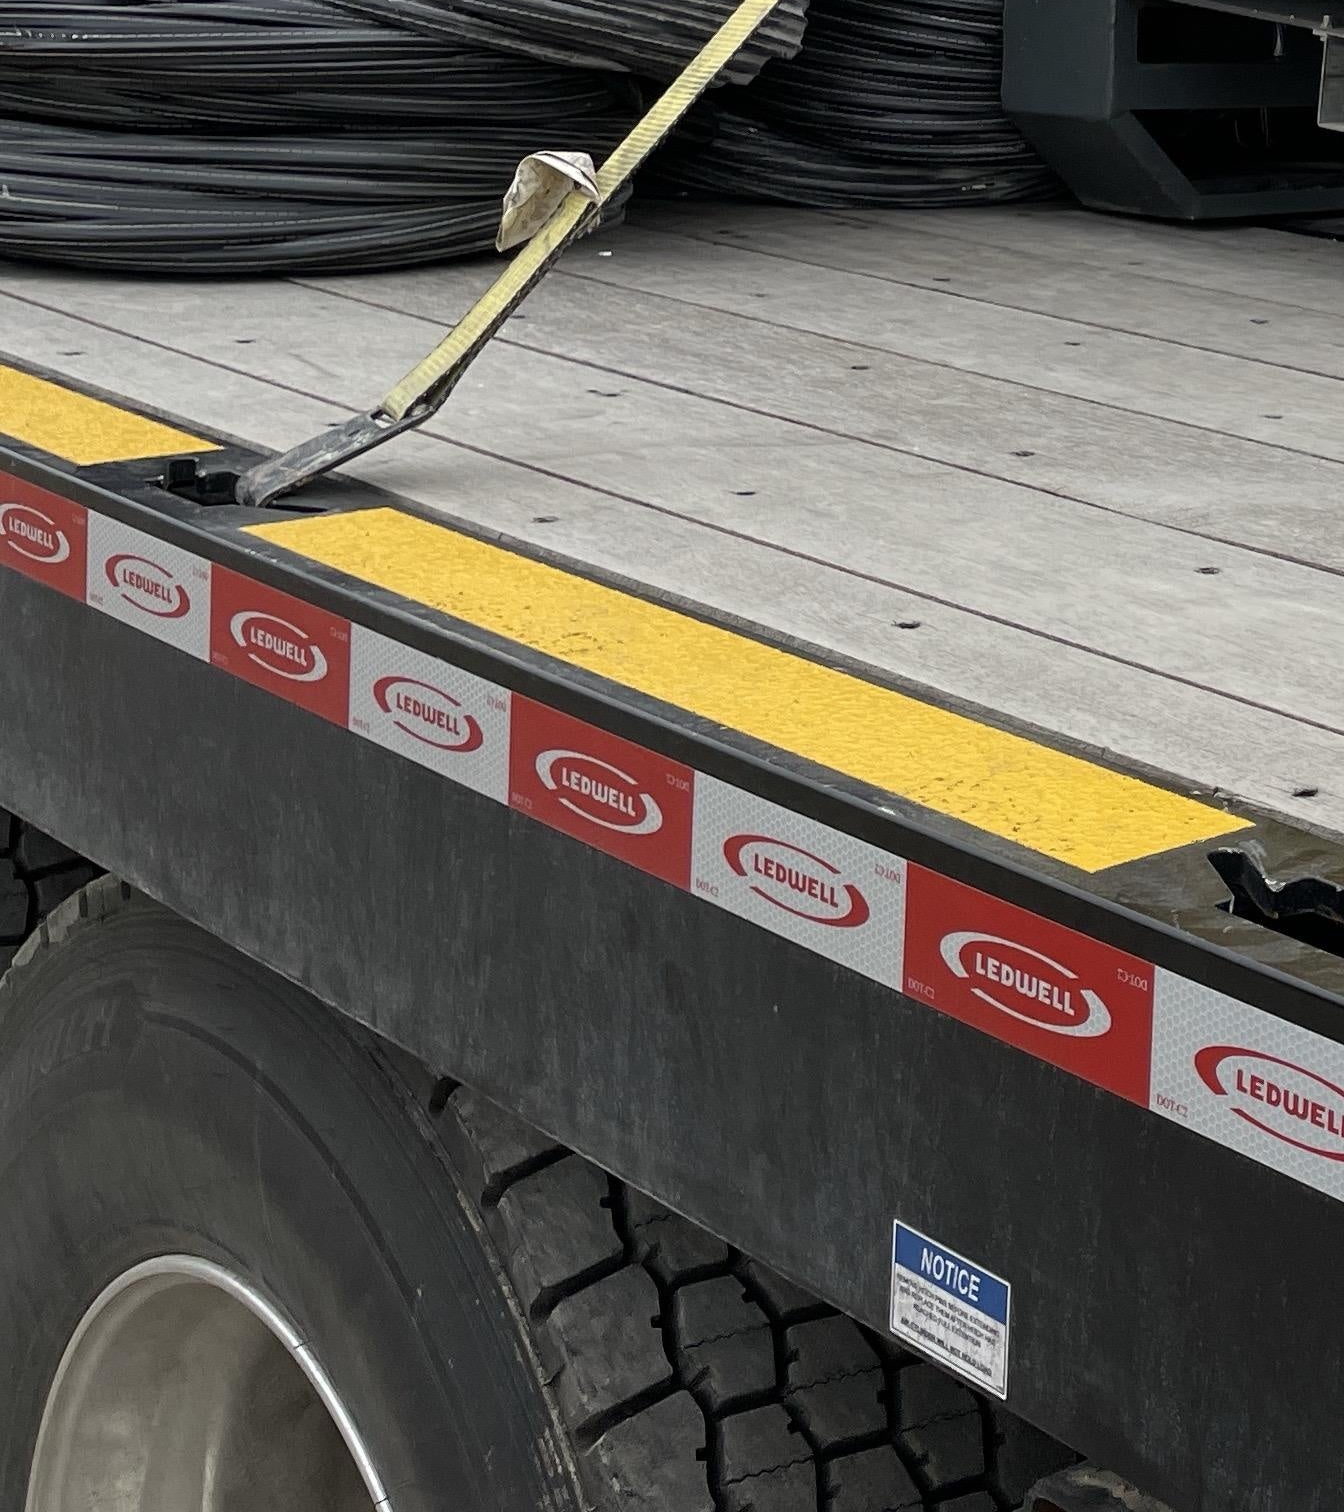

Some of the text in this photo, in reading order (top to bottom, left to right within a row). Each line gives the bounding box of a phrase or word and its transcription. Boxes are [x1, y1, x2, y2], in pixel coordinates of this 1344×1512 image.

[8, 515, 54, 550] LEDWELL
[122, 567, 173, 604] LEDWELL
[249, 625, 308, 667] LEDWELL
[395, 691, 461, 736] LEDWELL
[561, 766, 637, 818] LEDWELL
[753, 852, 839, 908] LEDWELL
[907, 977, 936, 1000] DOT-C2
[975, 951, 1076, 1017] LEDWELL
[1116, 967, 1149, 992] DOT-C2
[1155, 1093, 1189, 1119] DOT-C2
[919, 1246, 982, 1304] NOTICE
